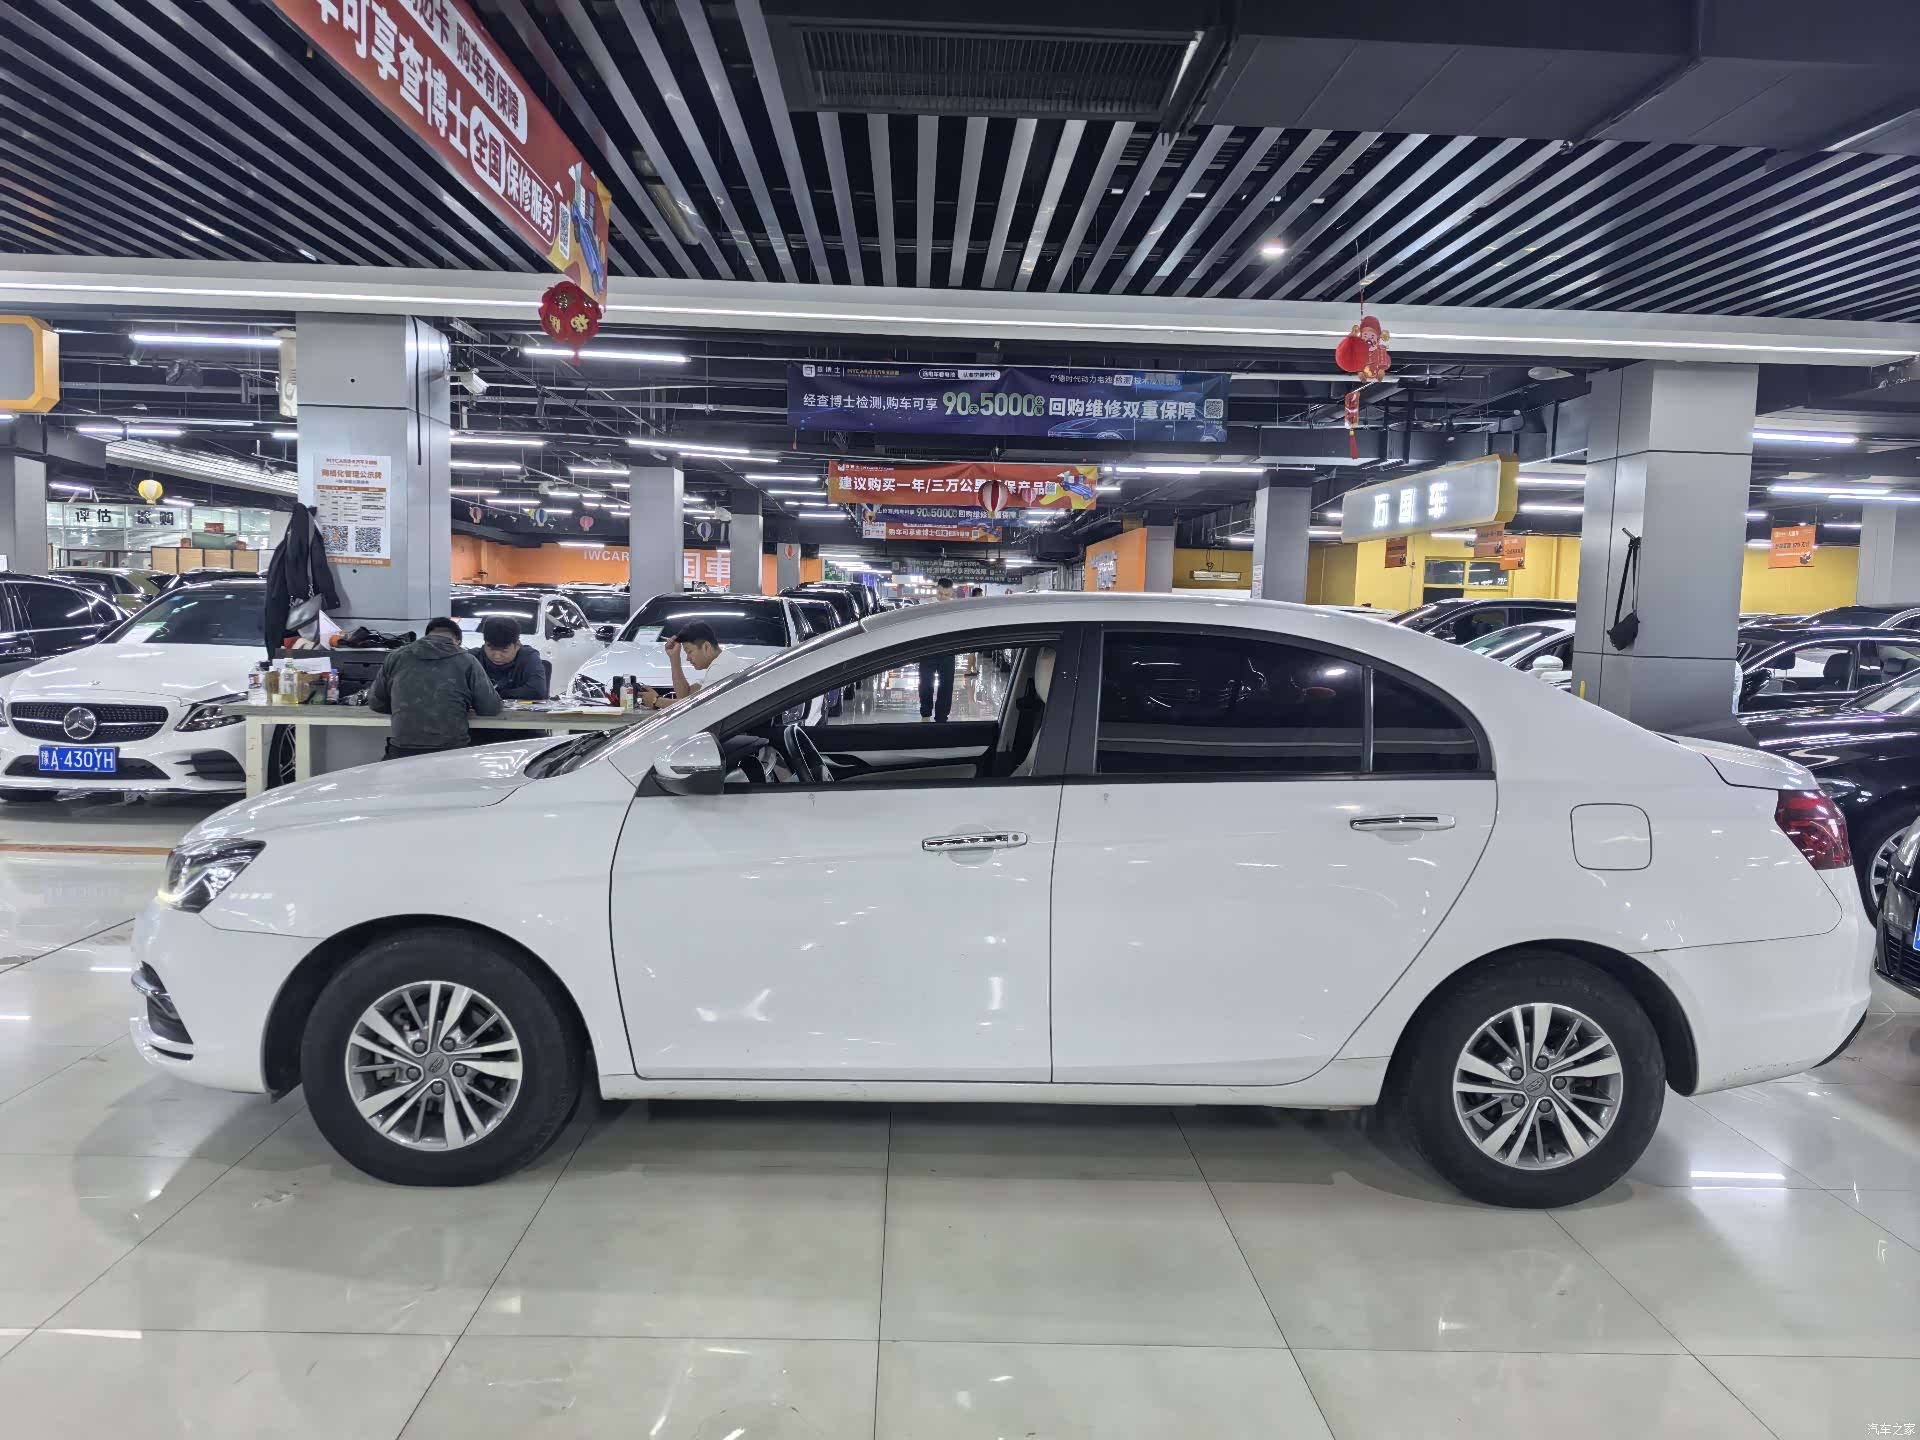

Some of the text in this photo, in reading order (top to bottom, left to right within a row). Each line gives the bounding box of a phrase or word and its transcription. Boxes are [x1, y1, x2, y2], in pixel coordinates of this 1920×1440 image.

[456, 22, 519, 129] 购车有保障
[1049, 397, 1197, 420] 回购维修双重保障
[838, 476, 1045, 496] 建议购买一年/三万公里保产品
[75, 508, 112, 523] 评估
